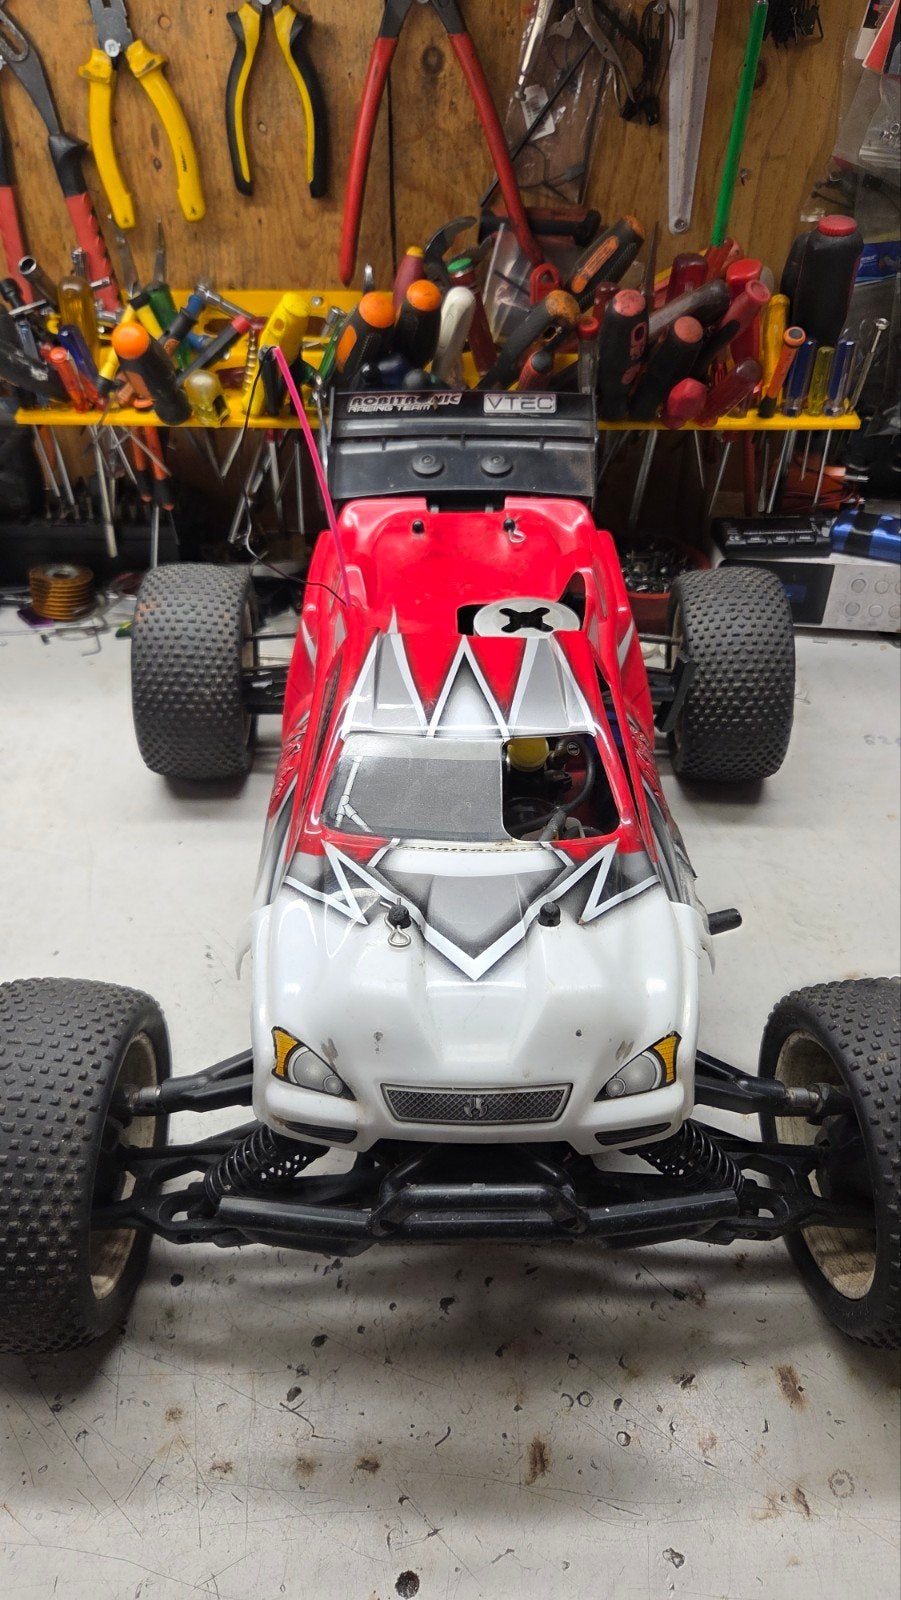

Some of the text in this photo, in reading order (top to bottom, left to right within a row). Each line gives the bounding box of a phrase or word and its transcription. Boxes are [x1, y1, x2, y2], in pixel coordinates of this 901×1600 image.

[349, 393, 462, 405] ROBITRNIC
[487, 396, 553, 410] VTEC
[348, 403, 431, 413] RACING TEAM
